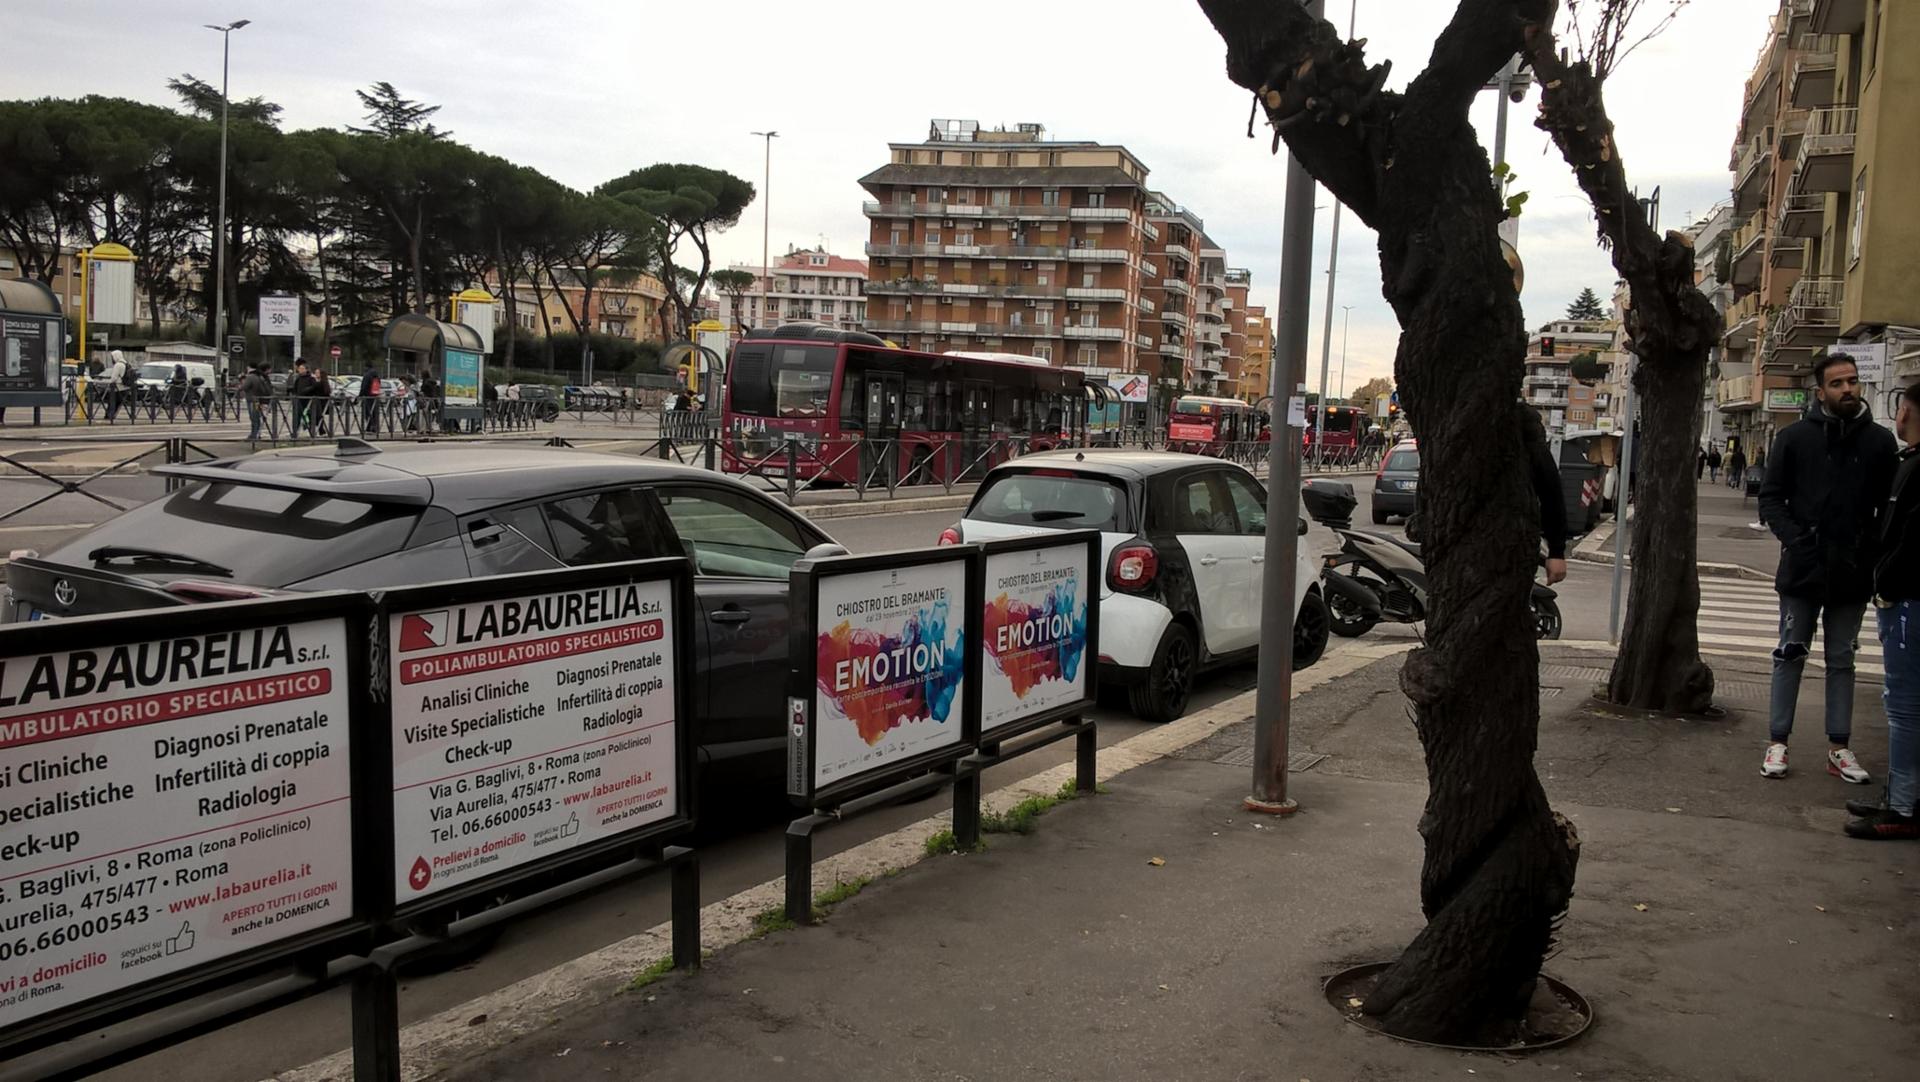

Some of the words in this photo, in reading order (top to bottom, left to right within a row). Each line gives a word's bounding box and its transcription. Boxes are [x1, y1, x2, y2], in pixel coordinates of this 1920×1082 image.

[268, 313, 290, 325] -50%
[734, 417, 766, 433] FIDIA
[998, 573, 1029, 589] CHIOSTRO
[1030, 571, 1042, 584] DEL
[1043, 567, 1074, 582] BRAMANTE
[456, 585, 640, 644] LABAURELIA
[642, 600, 663, 615] s.r.l.
[836, 596, 881, 617] CHIOSTRO
[883, 594, 900, 610] DEL
[901, 587, 945, 605] BRAMANTE
[997, 612, 1074, 652] EMOTION
[0, 626, 294, 706] LABAURELIA
[297, 645, 330, 663] s.r.l.
[411, 640, 560, 678] POLIAMBULATORIO
[565, 624, 657, 651] SPECIALISTICO
[556, 661, 610, 687] Diagnosi
[612, 652, 662, 675] Prenatale
[835, 639, 945, 692] EMOTION
[0, 700, 160, 742] MBULATORIO
[169, 674, 321, 714] SPECIALISTICO
[421, 687, 472, 713] Analisi
[475, 678, 529, 702] Cliniche
[557, 684, 613, 712] Infertilità
[615, 681, 626, 700] di
[628, 677, 663, 701] coppia
[154, 725, 241, 759] Diagnosi
[245, 711, 328, 742] Prenatale
[404, 720, 447, 744] Visite
[451, 702, 545, 738] Specialistiche
[583, 705, 643, 732] Radiologia
[17, 753, 108, 785] Cliniche
[155, 757, 246, 793] Infertilità
[251, 748, 269, 772] di
[272, 743, 330, 770] coppia
[430, 781, 452, 801] Via
[456, 776, 471, 794] G.
[475, 765, 525, 791] Baglivi,
[528, 762, 536, 776] 8
[546, 751, 580, 771] Roma
[583, 746, 606, 763] (zona
[607, 735, 651, 757] Policlinico)
[445, 738, 512, 764] Check-up
[0, 781, 134, 826] pecialistiche
[199, 781, 297, 816] Radiologia
[430, 803, 453, 822] Via
[455, 791, 508, 817] Aurelia,
[511, 776, 558, 801] 475/477
[568, 765, 601, 785] Roma
[431, 826, 458, 844] Tel.
[462, 799, 552, 835] 06.66000543
[563, 771, 652, 807] www.labaurelia.it
[595, 798, 625, 816] APERTO
[601, 811, 621, 826] anche
[629, 799, 663, 817] DOMENICA
[0, 828, 80, 862] eck-up
[20, 863, 101, 899] Baglivi,
[107, 859, 119, 877] 8
[137, 844, 193, 870] Roma
[199, 836, 236, 858] (zona
[240, 816, 311, 843] Policlinico)
[433, 848, 472, 868] Prelievi
[473, 847, 480, 858] a
[481, 831, 526, 855] domicilio
[533, 834, 559, 847] facebook
[80, 876, 157, 912] 475/477
[175, 861, 229, 886] Roma
[441, 865, 456, 879] ogni
[457, 861, 472, 873] zona
[0, 904, 149, 960] 06.66000543
[168, 863, 312, 914] www.labaurelia.it
[222, 901, 265, 924] APERTO
[266, 893, 297, 913] TUTTI
[302, 880, 338, 900] GIORNI
[231, 918, 263, 936] anche
[264, 914, 274, 926] la
[275, 898, 330, 922] DOMENICA
[120, 943, 150, 960] seguici
[152, 939, 162, 949] su
[121, 952, 163, 970] facebook
[19, 976, 29, 988] a
[33, 951, 108, 984] domicilio
[17, 983, 26, 999] di
[30, 980, 64, 999] Roma.
